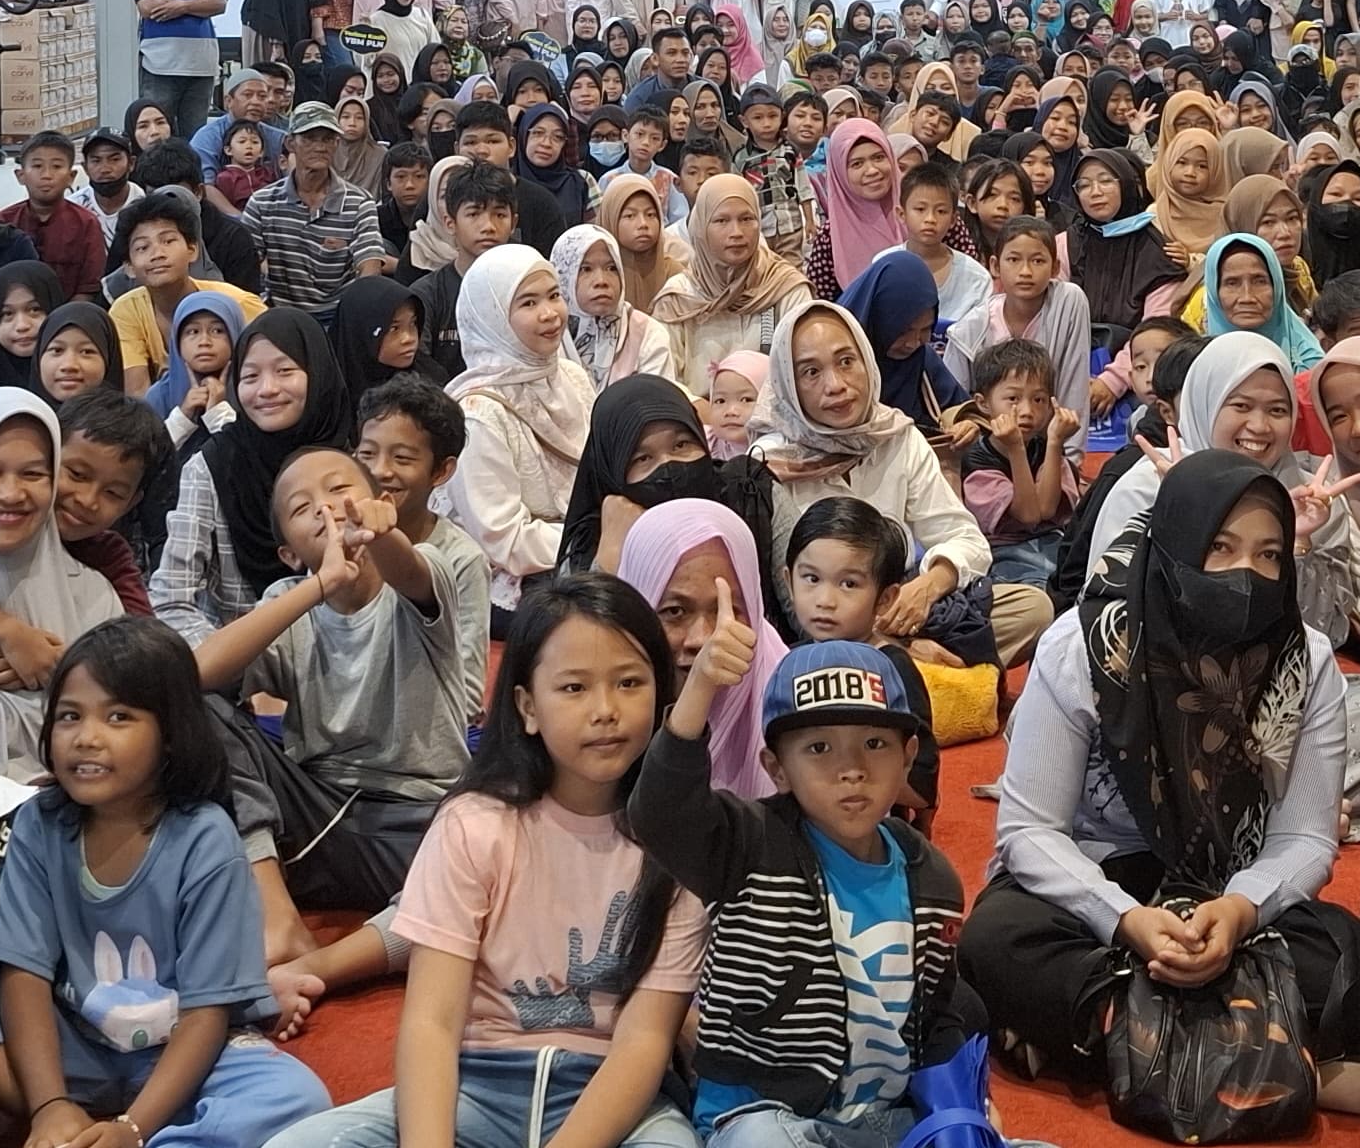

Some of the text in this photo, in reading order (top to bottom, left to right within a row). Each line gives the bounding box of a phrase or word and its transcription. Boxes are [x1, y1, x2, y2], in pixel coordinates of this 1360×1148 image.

[10, 69, 34, 77] carvil
[11, 94, 34, 102] carvil
[12, 119, 36, 127] carvil
